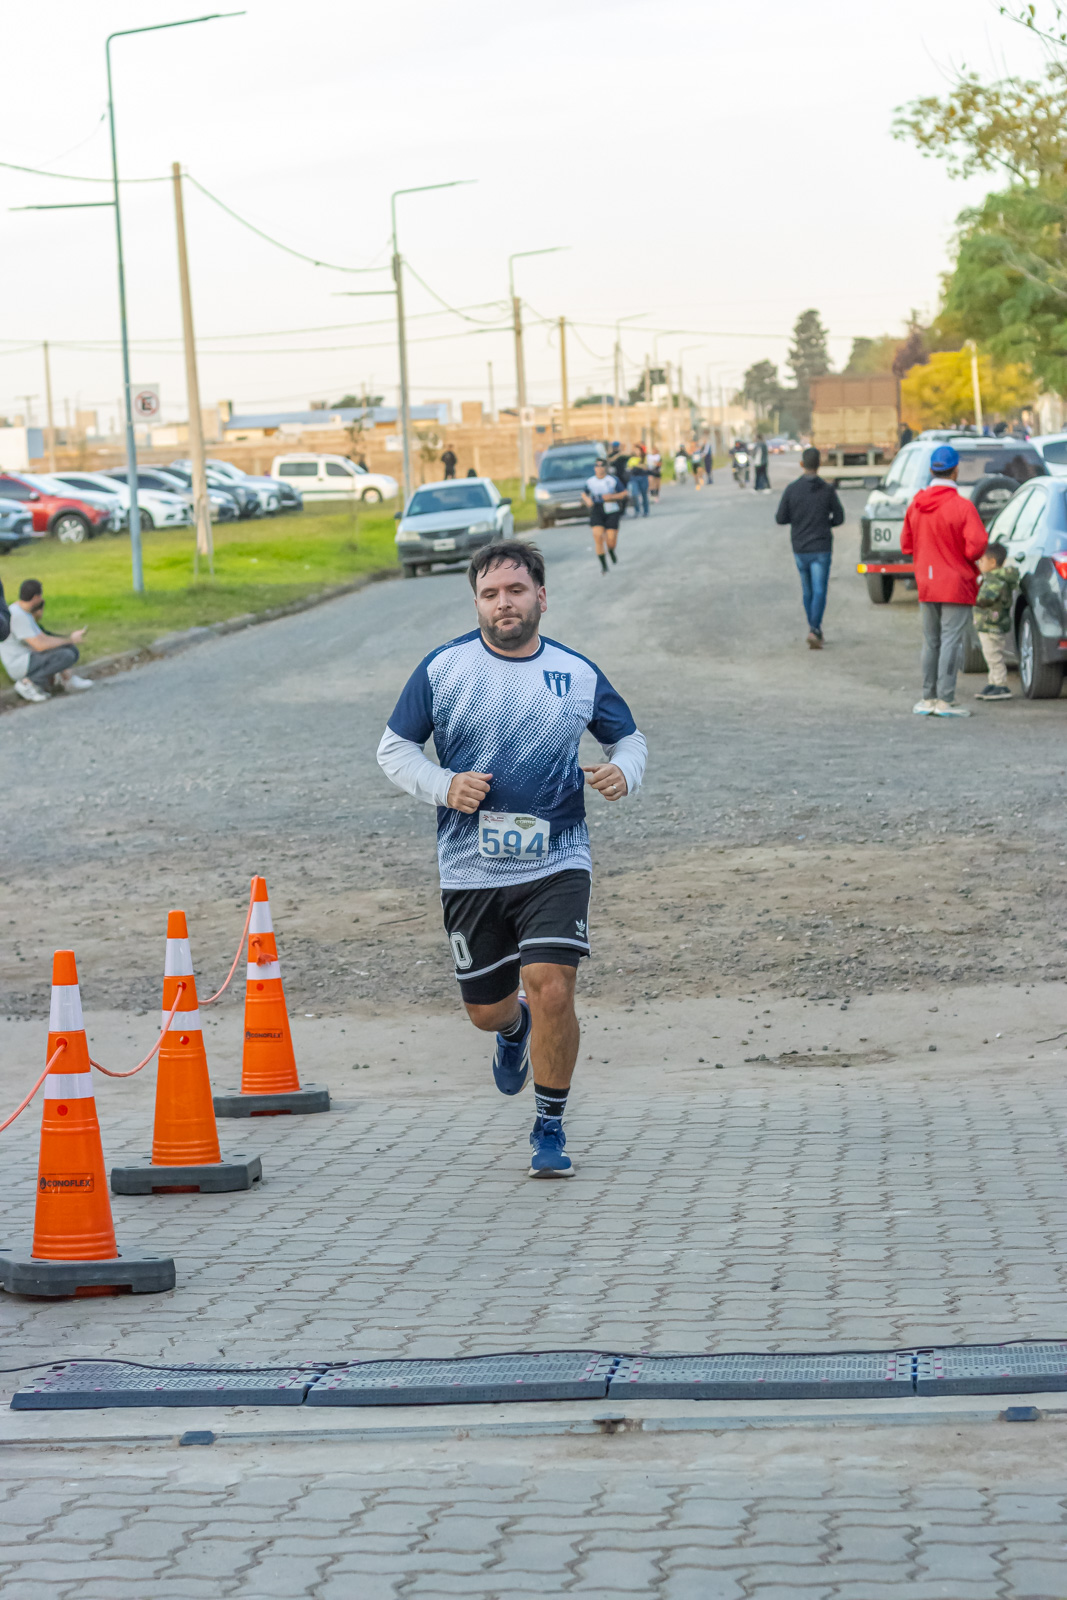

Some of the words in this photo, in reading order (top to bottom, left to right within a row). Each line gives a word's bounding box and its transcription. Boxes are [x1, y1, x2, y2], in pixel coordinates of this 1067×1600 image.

[874, 528, 892, 542] 80
[548, 672, 567, 681] SFC
[482, 828, 545, 858] 594
[46, 1179, 91, 1187] CONOFLEX
